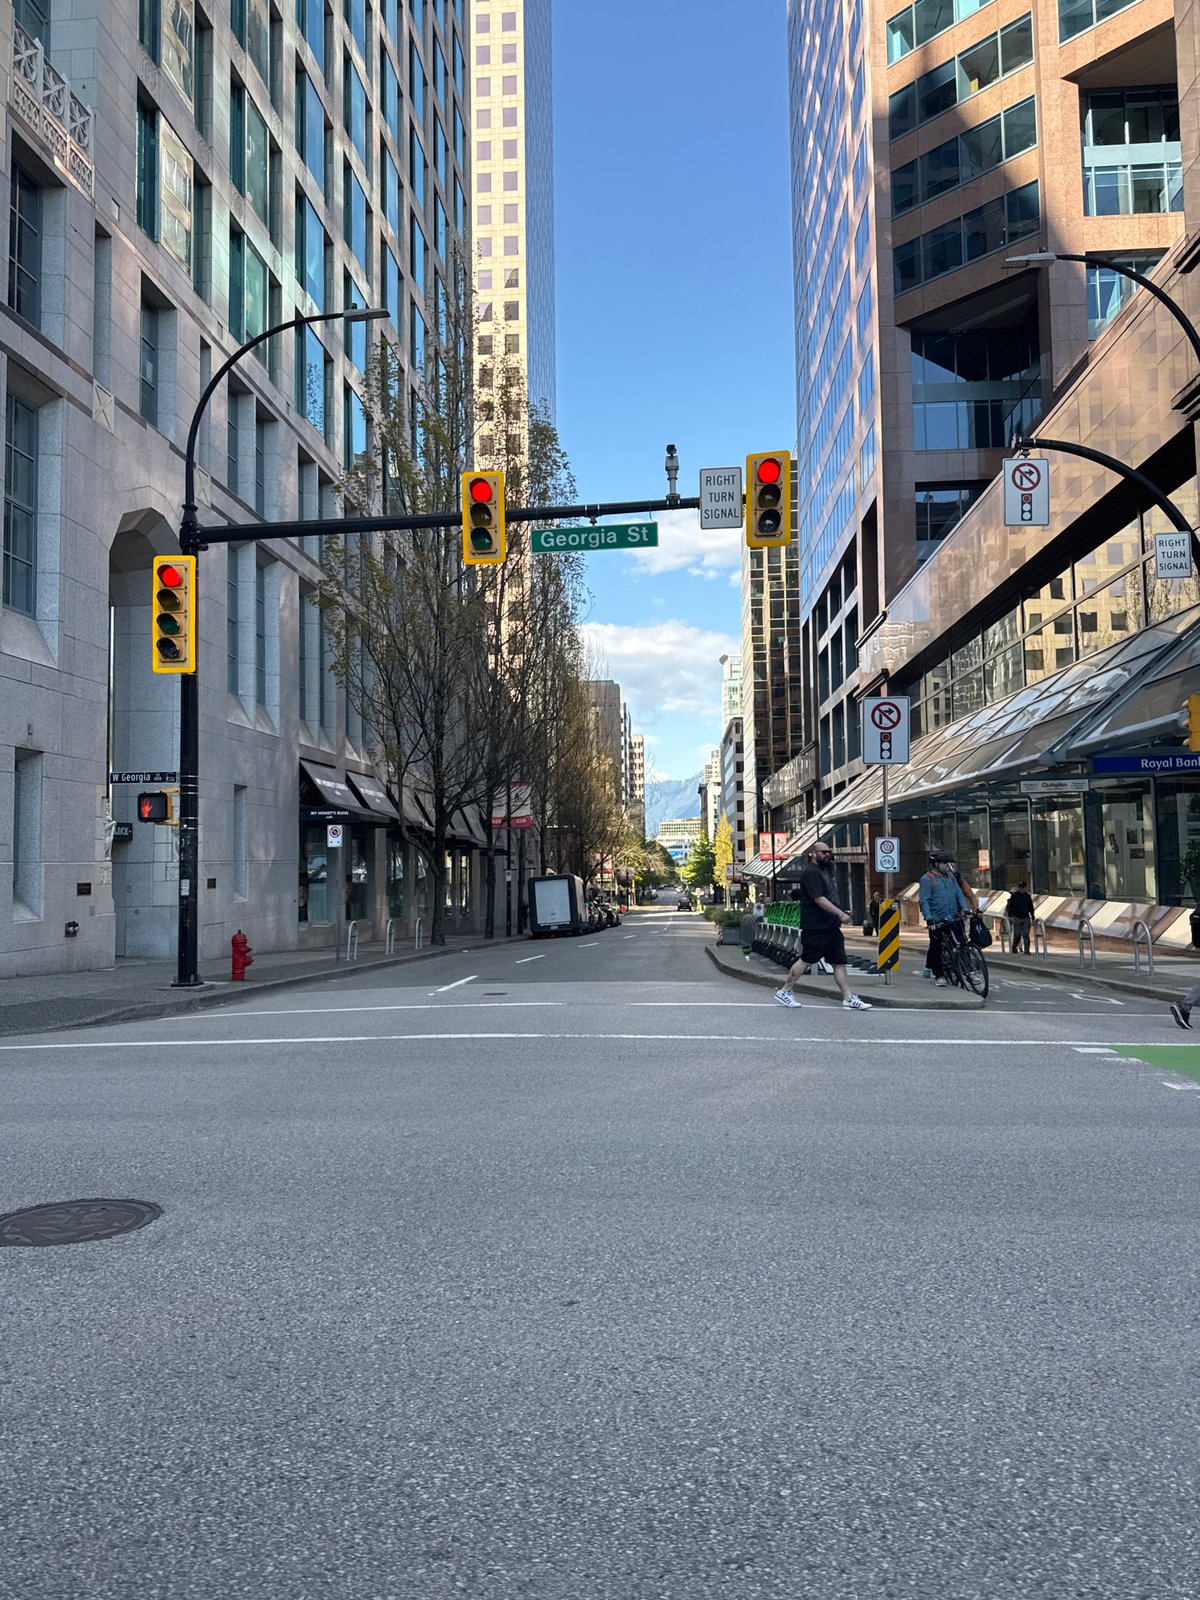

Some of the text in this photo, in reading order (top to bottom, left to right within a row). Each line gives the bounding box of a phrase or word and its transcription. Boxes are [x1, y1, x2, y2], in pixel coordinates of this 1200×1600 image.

[706, 475, 736, 486] RIGHT
[708, 492, 734, 502] TURN
[704, 508, 739, 519] SIGNAL
[540, 526, 649, 548] Georgia St
[1158, 539, 1186, 547] RIGHT
[1161, 550, 1186, 558] TURN
[1159, 562, 1188, 570] SIGNAL
[1141, 757, 1173, 771] Royal
[121, 773, 151, 784] Georgia
